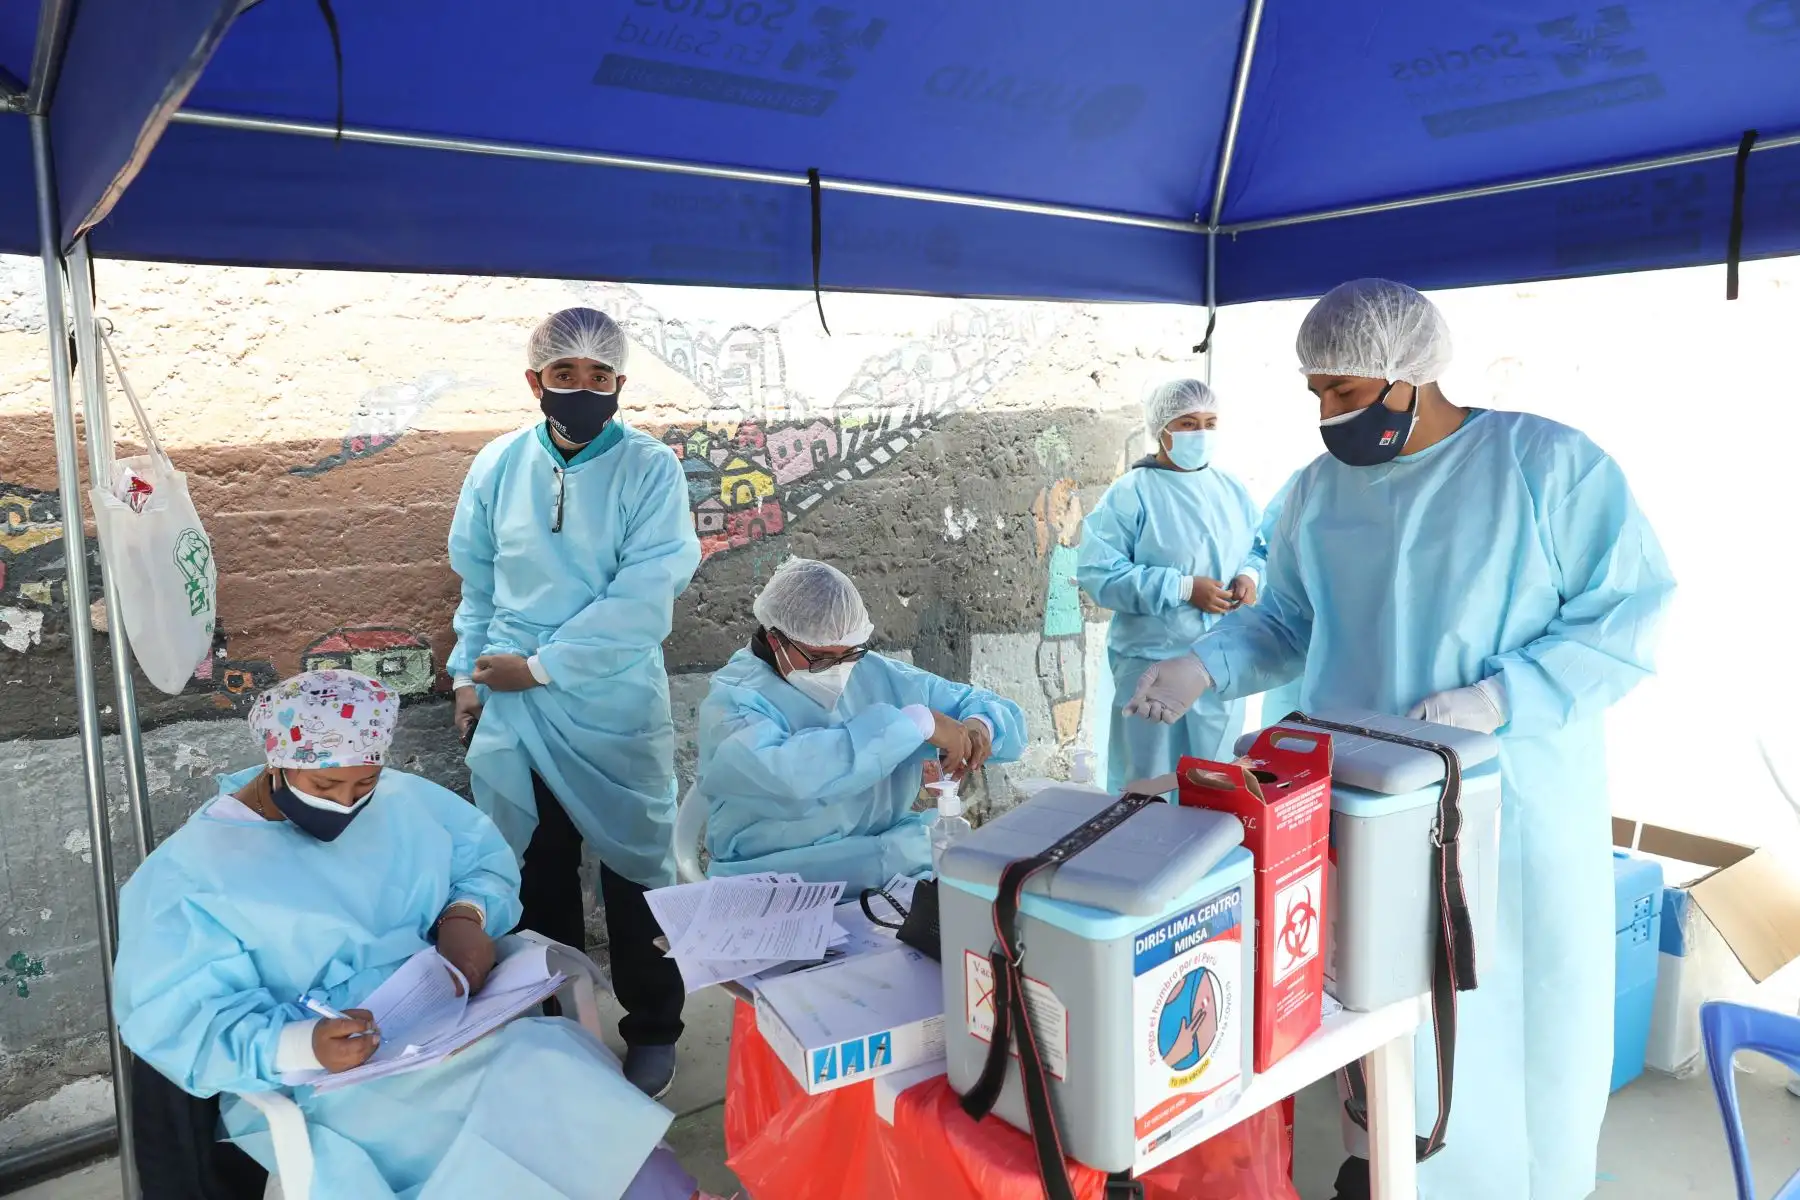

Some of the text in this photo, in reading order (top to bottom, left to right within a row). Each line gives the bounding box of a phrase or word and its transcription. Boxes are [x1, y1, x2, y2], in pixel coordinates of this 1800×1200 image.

[1135, 891, 1240, 956] DIRIS LIMA CENTRO
[1174, 927, 1208, 954] MINSA
[1151, 970, 1178, 1014] hombro
[1179, 957, 1192, 977] por
[1193, 952, 1201, 965] el
